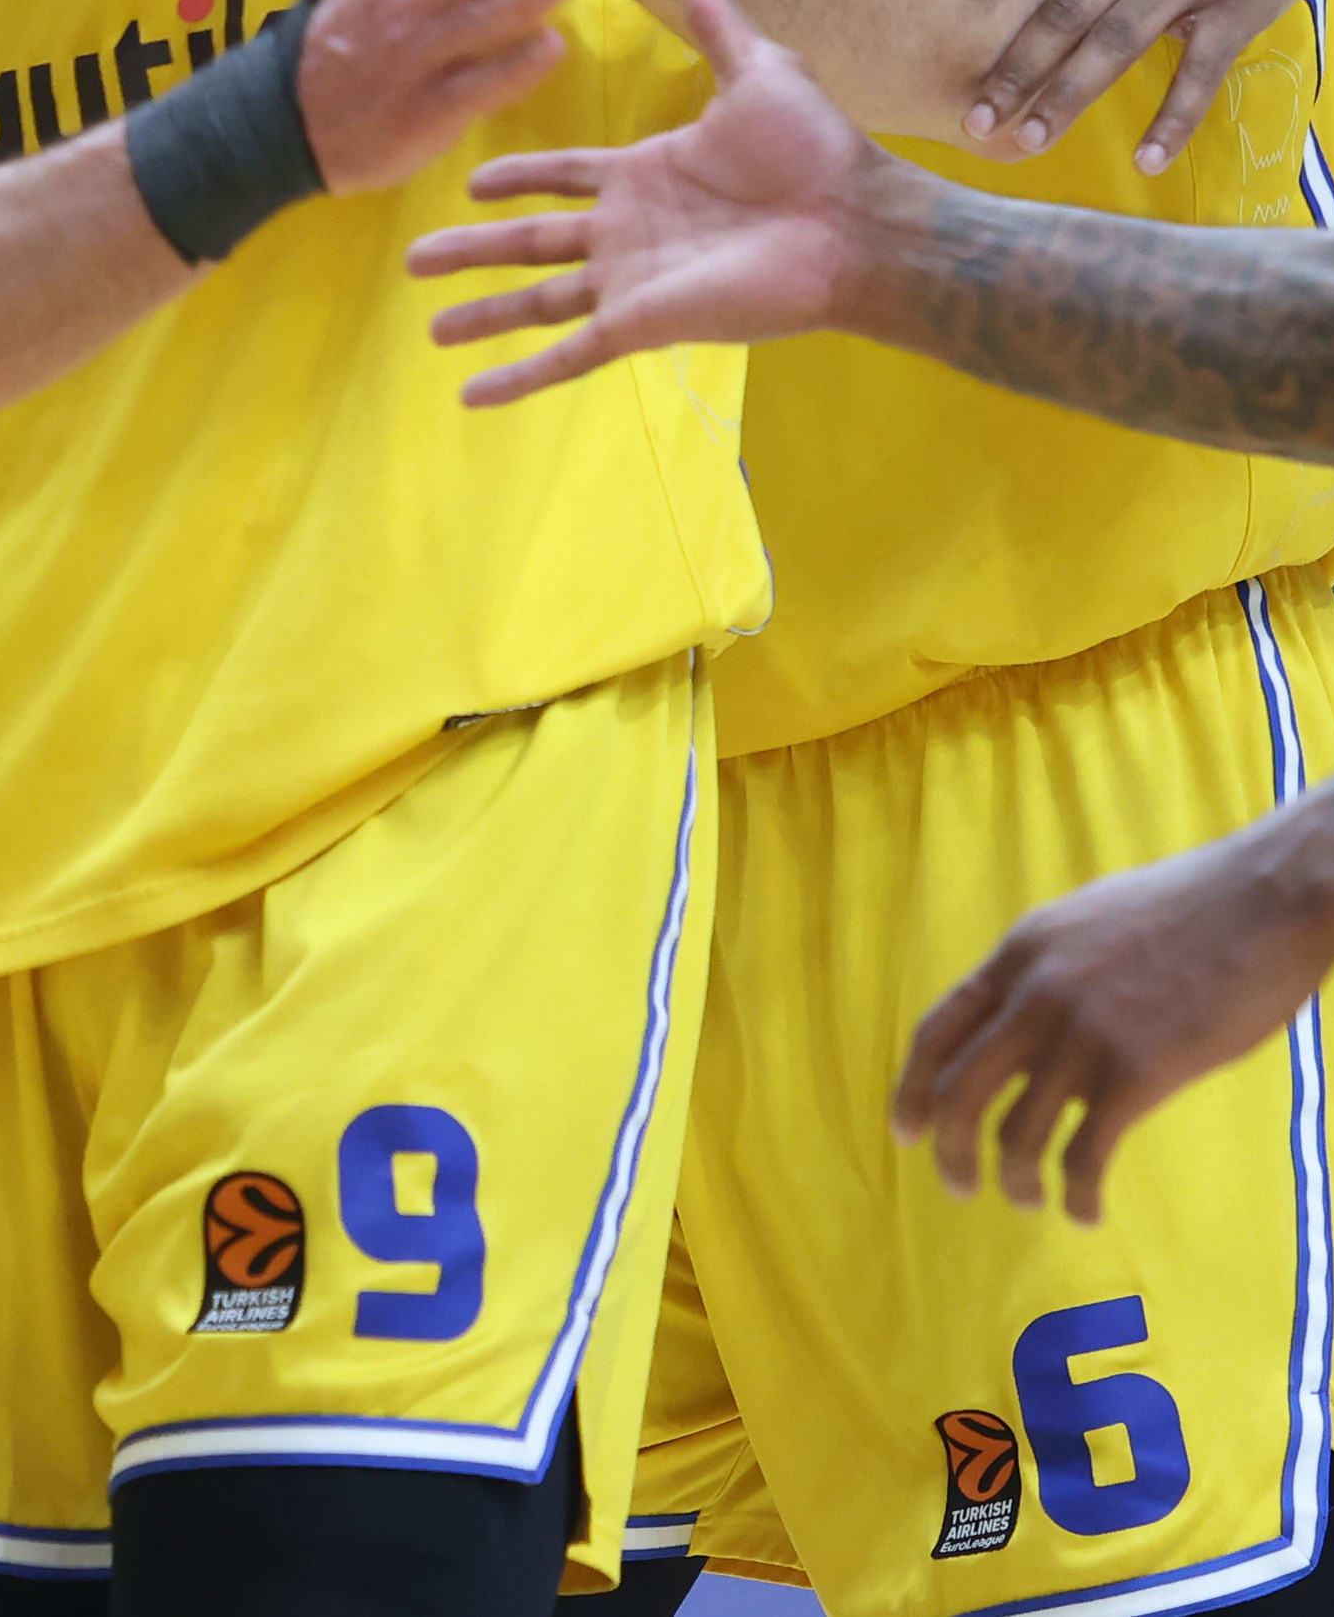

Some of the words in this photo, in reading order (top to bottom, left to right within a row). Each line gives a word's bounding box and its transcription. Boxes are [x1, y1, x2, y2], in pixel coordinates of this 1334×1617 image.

[338, 1104, 486, 1343] 9
[212, 1285, 295, 1310] TURKISH
[203, 1305, 290, 1325] AIRLINES
[1012, 1294, 1191, 1537] 6
[951, 1498, 1013, 1525] TURKISH
[946, 1515, 1010, 1541] AIRLINES
[939, 1533, 1006, 1553] EuroLeague
